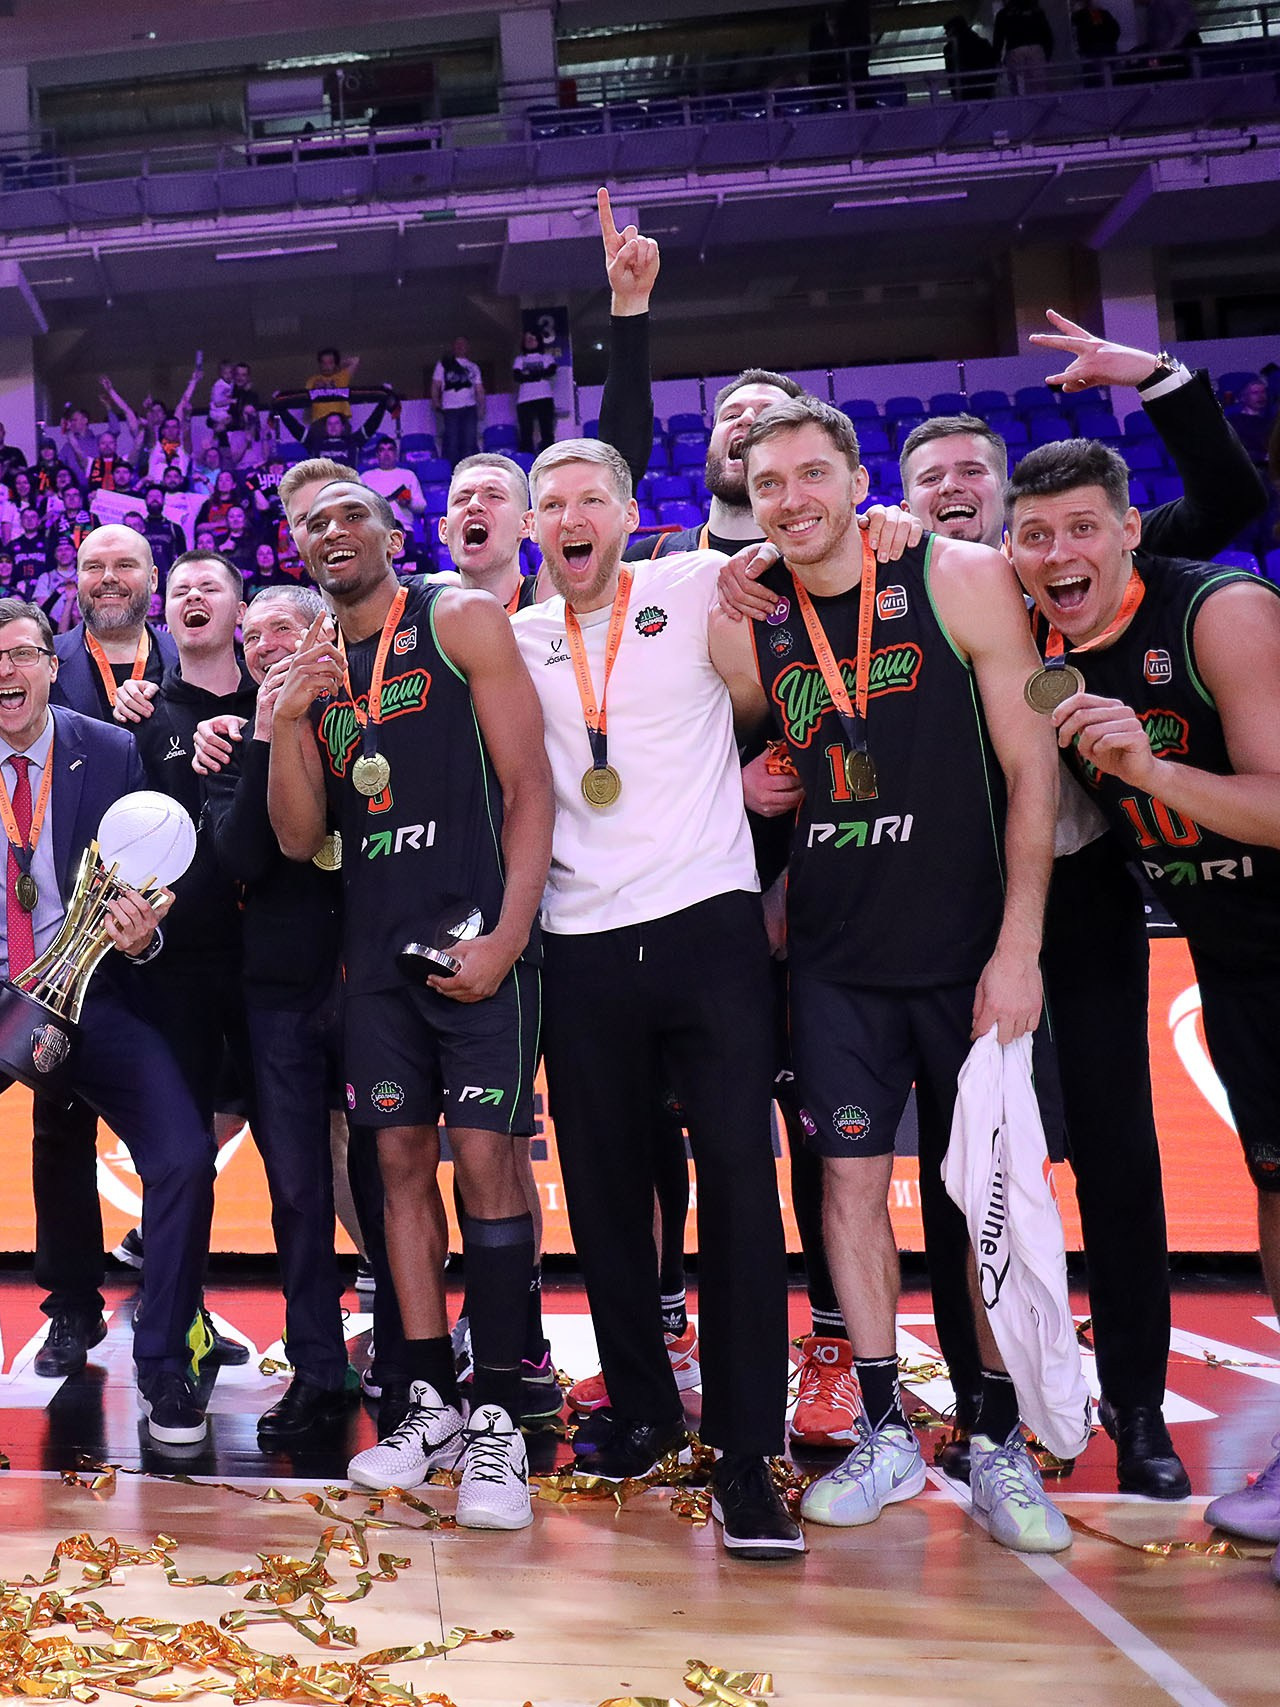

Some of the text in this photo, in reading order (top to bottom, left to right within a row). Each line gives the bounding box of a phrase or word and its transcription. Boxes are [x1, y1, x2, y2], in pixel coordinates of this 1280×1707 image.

[537, 314, 556, 345] 3
[883, 597, 906, 609] Win
[544, 653, 572, 667] JÖGEL
[824, 743, 878, 802] 1
[807, 813, 914, 849] PARI
[1120, 795, 1203, 849] 10
[1142, 855, 1254, 886] PARI
